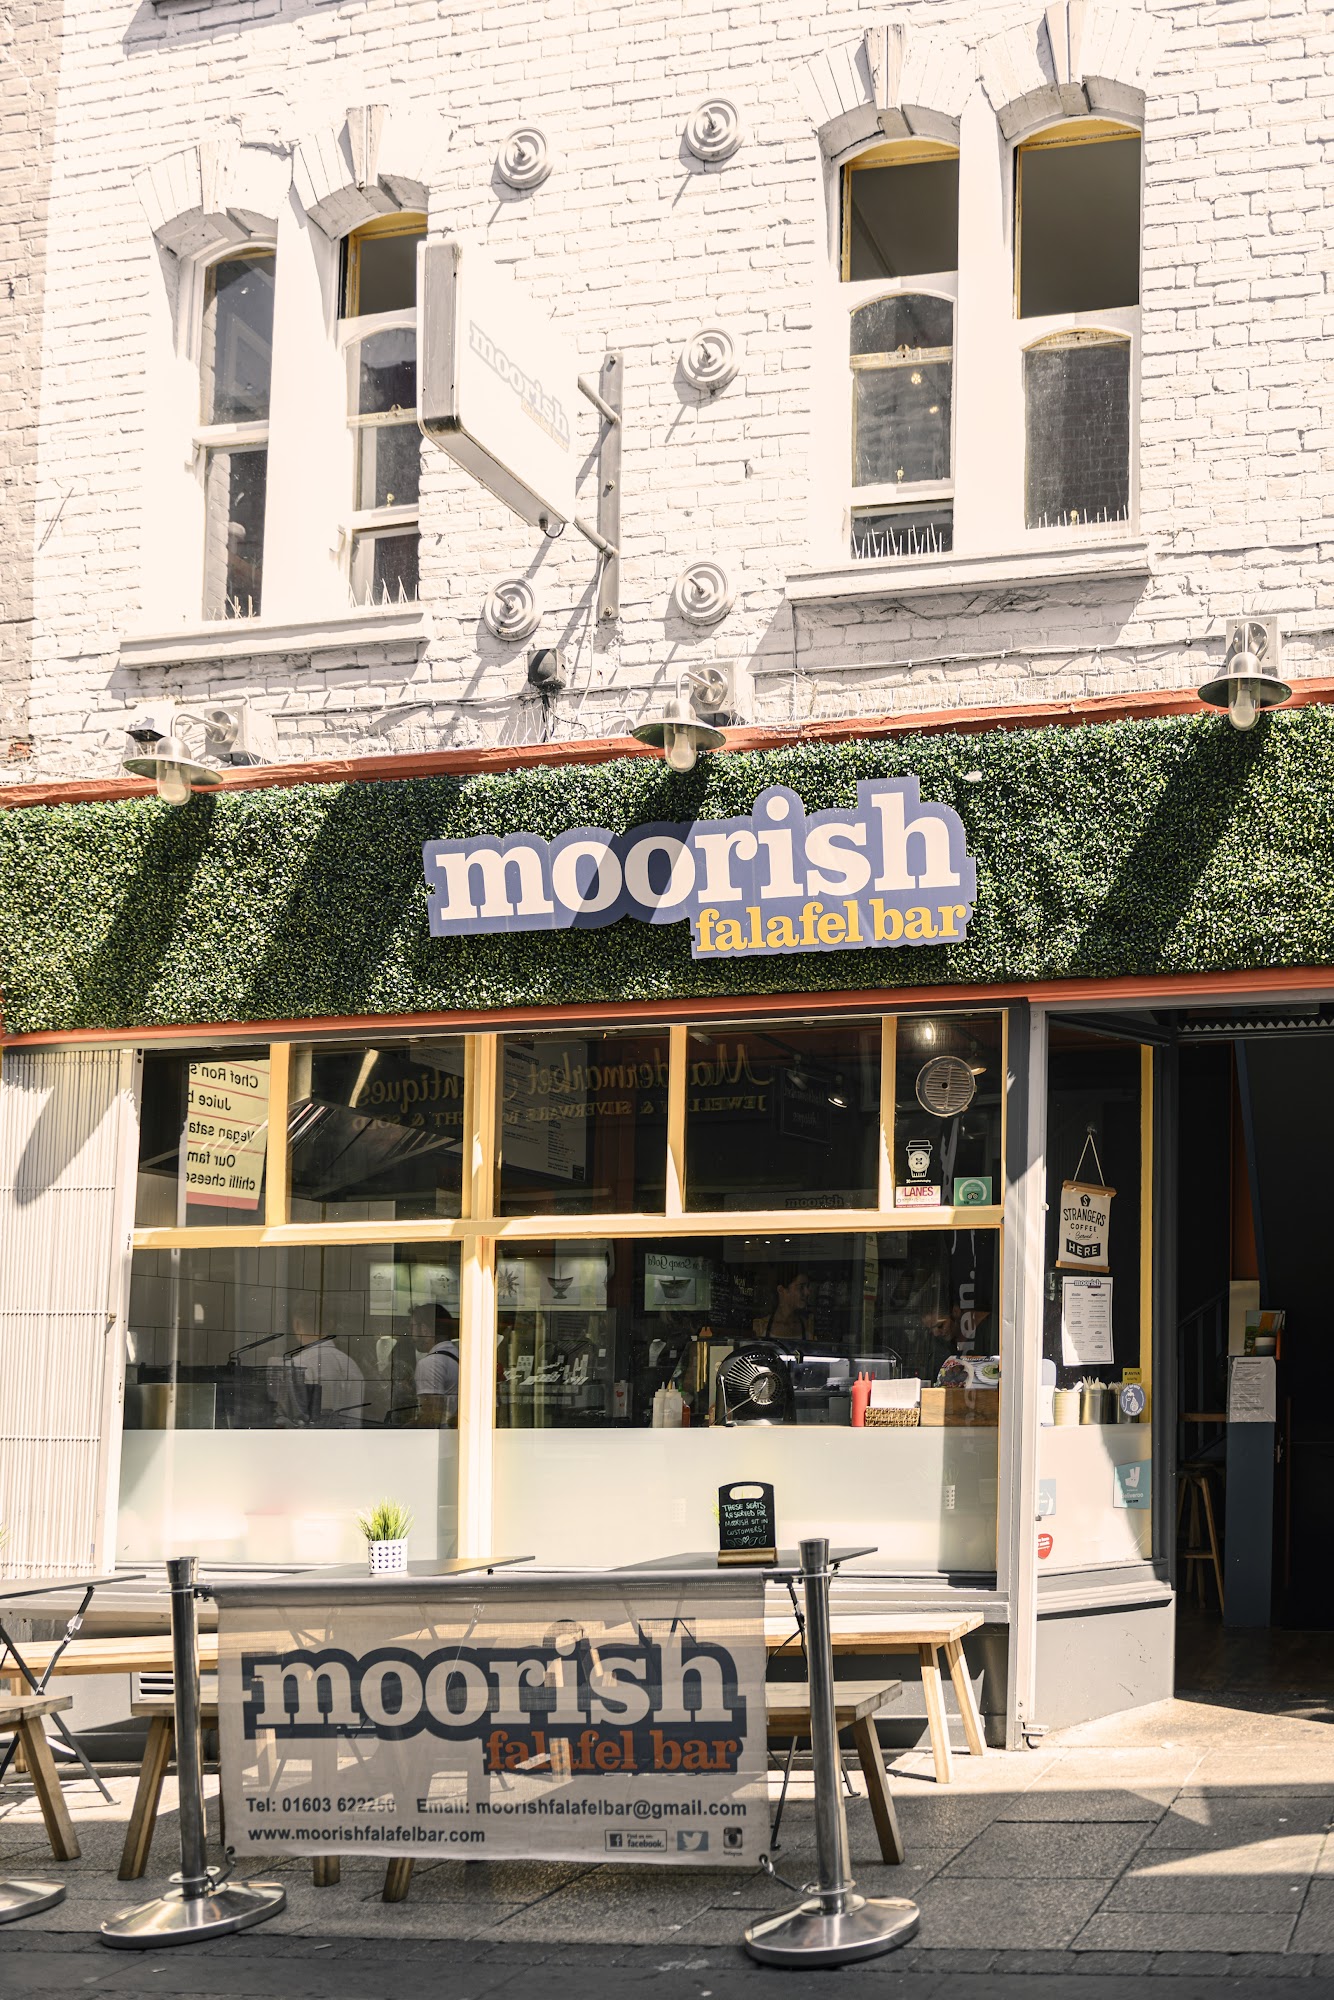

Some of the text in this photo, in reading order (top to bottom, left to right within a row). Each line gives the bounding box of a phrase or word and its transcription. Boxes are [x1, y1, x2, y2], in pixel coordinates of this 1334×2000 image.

[469, 320, 571, 445] moorish
[436, 792, 961, 921] moorish
[696, 897, 967, 953] falafel bar
[903, 1186, 934, 1197] LANES
[785, 1194, 845, 1210] moorish
[1063, 1207, 1107, 1227] STRANGERS
[1070, 1222, 1097, 1233] COFFEE
[1068, 1242, 1098, 1257] HERE
[1074, 1279, 1102, 1287] moorish
[722, 1500, 766, 1512] THESE SEATS
[725, 1510, 755, 1519] RESERVED
[727, 1524, 766, 1536] CUSTOMERS!
[253, 1630, 734, 1728] moorish
[649, 1729, 738, 1770] bar
[246, 1797, 276, 1813] Tel:
[282, 1797, 332, 1813] 01603
[417, 1798, 470, 1814] Email:
[475, 1798, 747, 1820] moorishfalafelbar@gmail.com
[248, 1826, 486, 1843] www.moorishfalafelbar.com
